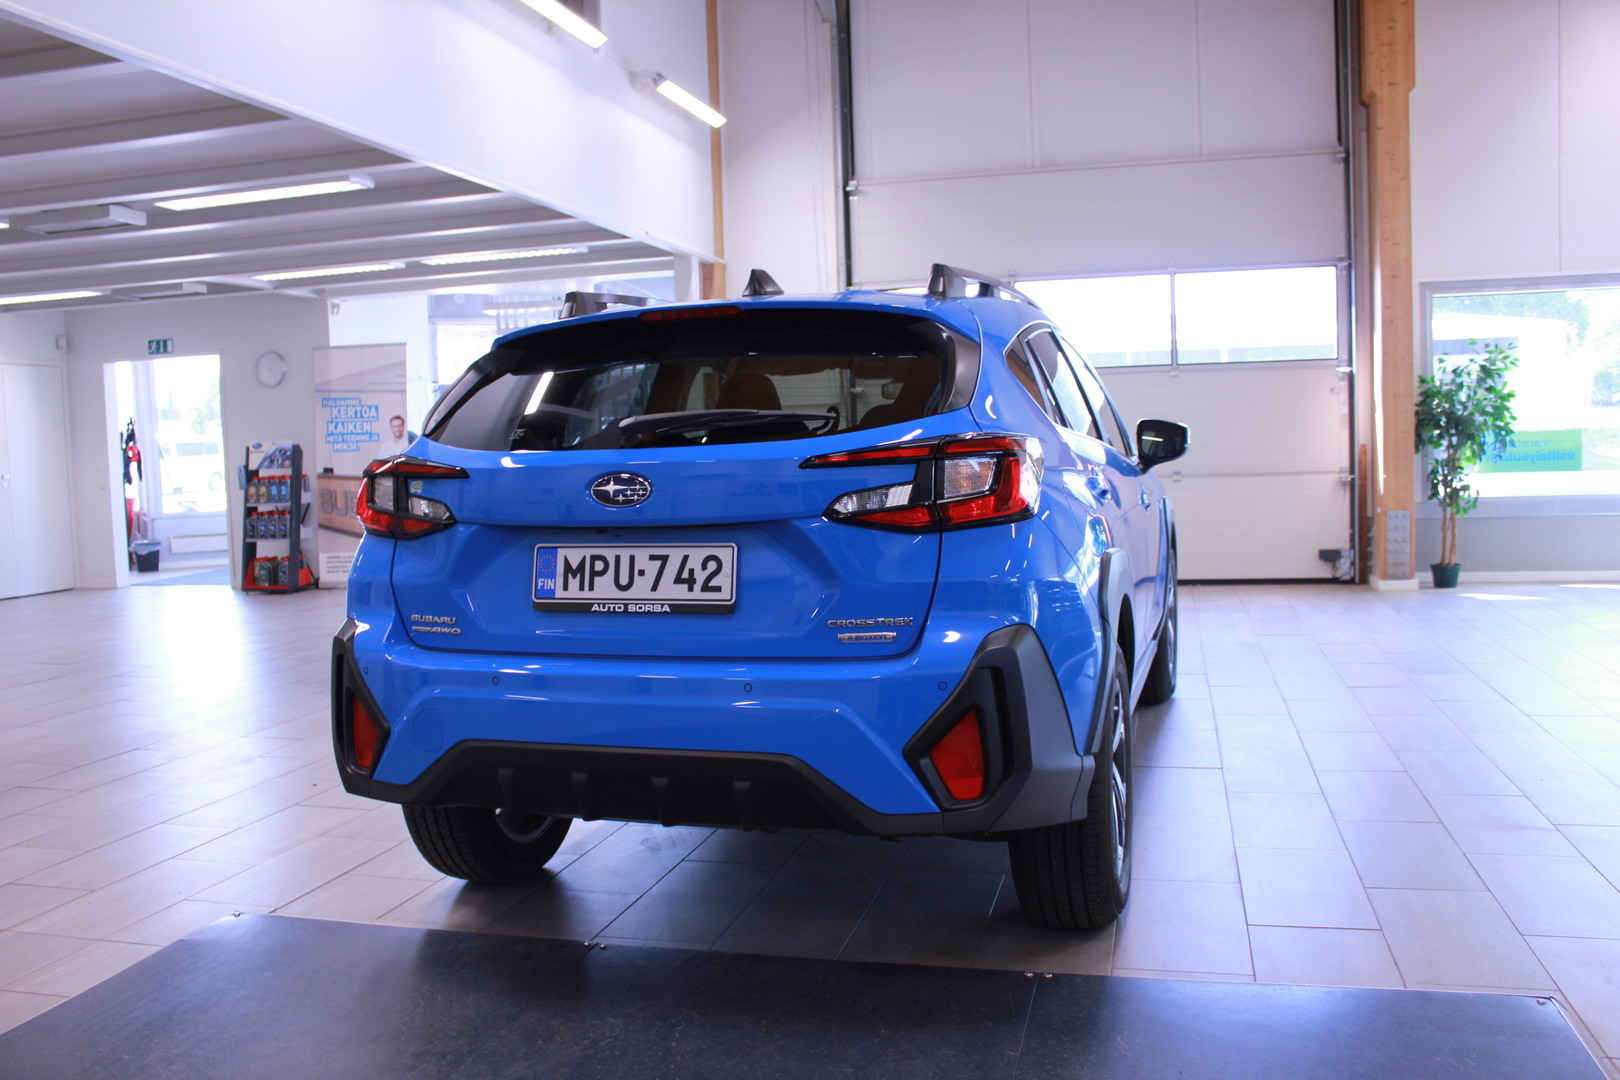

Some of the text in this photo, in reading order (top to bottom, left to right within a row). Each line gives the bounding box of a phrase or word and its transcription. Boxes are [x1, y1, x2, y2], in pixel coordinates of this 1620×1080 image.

[323, 399, 360, 407] HALUAMME
[332, 406, 377, 418] KERTOA
[328, 422, 371, 433] KAIKEN
[343, 434, 369, 442] TEEMME
[562, 554, 723, 592] MPU-742
[538, 578, 555, 590] FIN
[591, 604, 671, 613] AUTO SORSA
[411, 615, 456, 624] SUBARU
[827, 617, 914, 628] CROSSTREK
[430, 626, 461, 634] AWD
